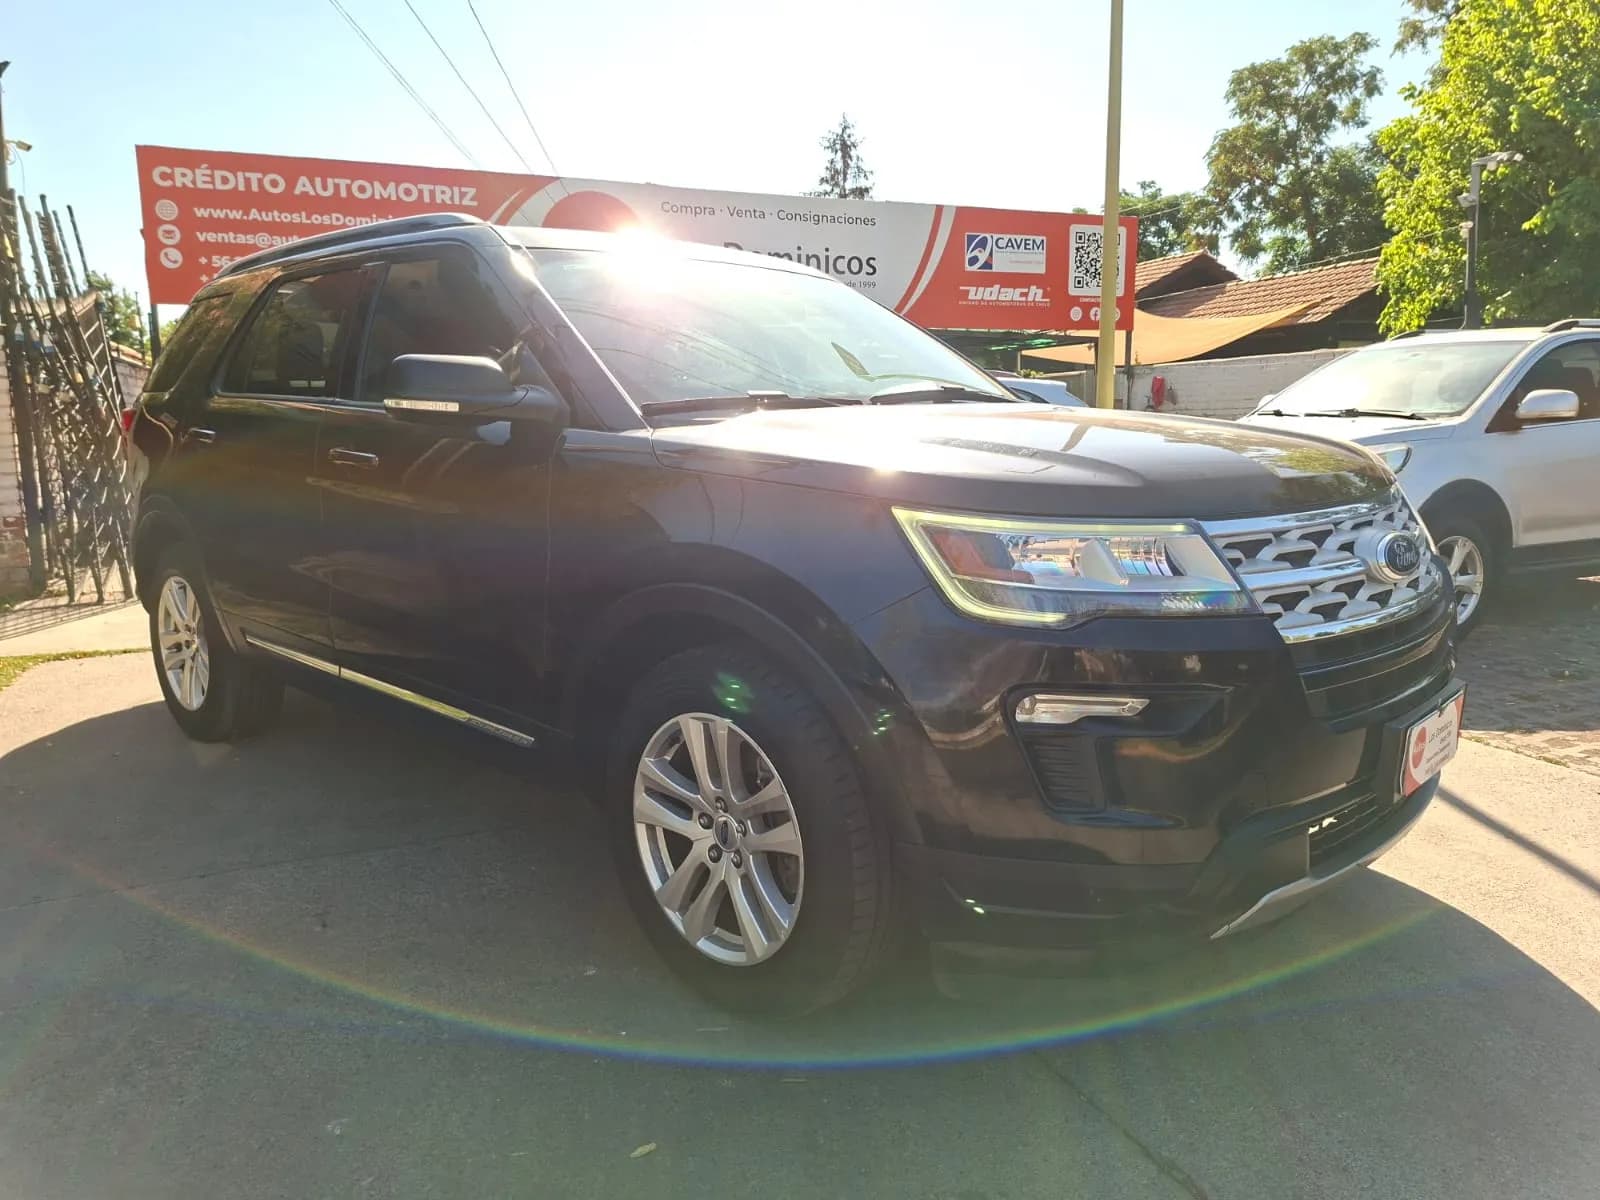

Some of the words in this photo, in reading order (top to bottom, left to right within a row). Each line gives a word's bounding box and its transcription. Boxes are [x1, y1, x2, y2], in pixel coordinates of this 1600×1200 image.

[152, 164, 286, 194] CRÉDITO
[294, 175, 478, 206] AUTOMOTRIZ
[193, 206, 394, 226] www.AutosLosDomi
[661, 201, 715, 217] Compra
[727, 206, 766, 219] Venta
[777, 209, 876, 226] Consignaciones
[196, 230, 302, 248] ventas@aut
[994, 237, 1045, 251] CAVEM
[859, 280, 877, 289] 1999
